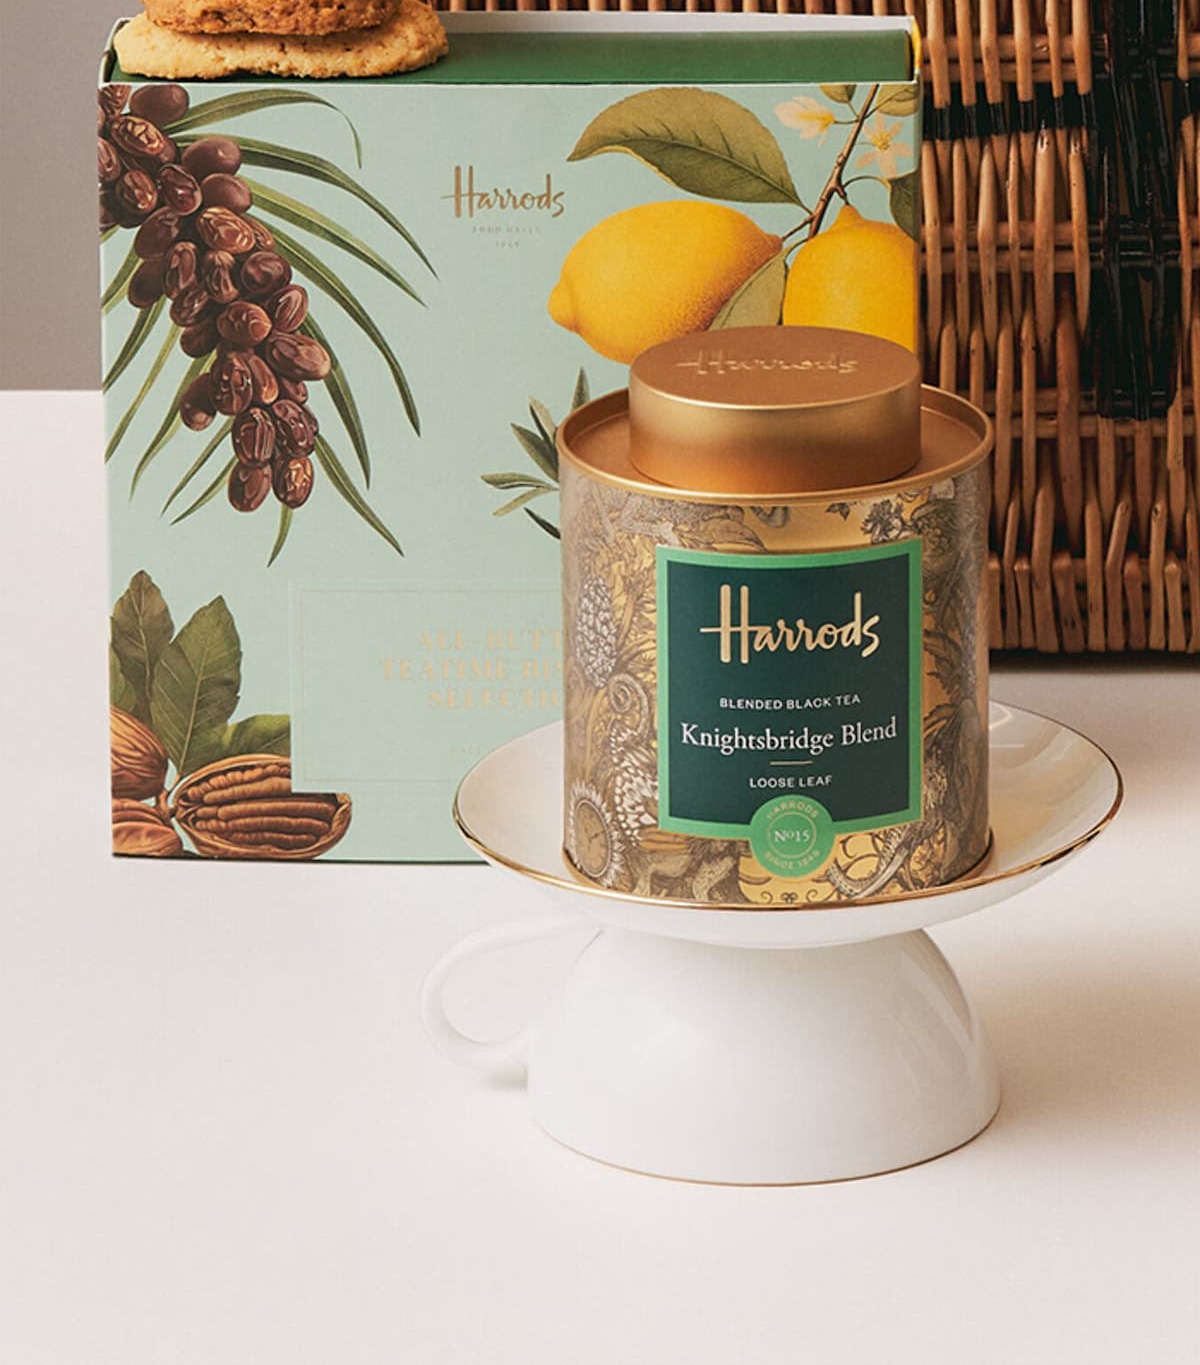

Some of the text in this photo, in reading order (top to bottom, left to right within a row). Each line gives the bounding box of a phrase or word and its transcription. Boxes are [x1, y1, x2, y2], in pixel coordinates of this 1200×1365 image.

[440, 165, 565, 218] Harrods
[677, 349, 858, 376] Harrods
[700, 584, 880, 664] Harrods
[719, 693, 861, 710] BLENDED BLACK TEA
[681, 716, 898, 755] Knightsbridge Blend
[749, 775, 833, 789] LOOSE LEAF
[766, 800, 820, 820] HARRODS
